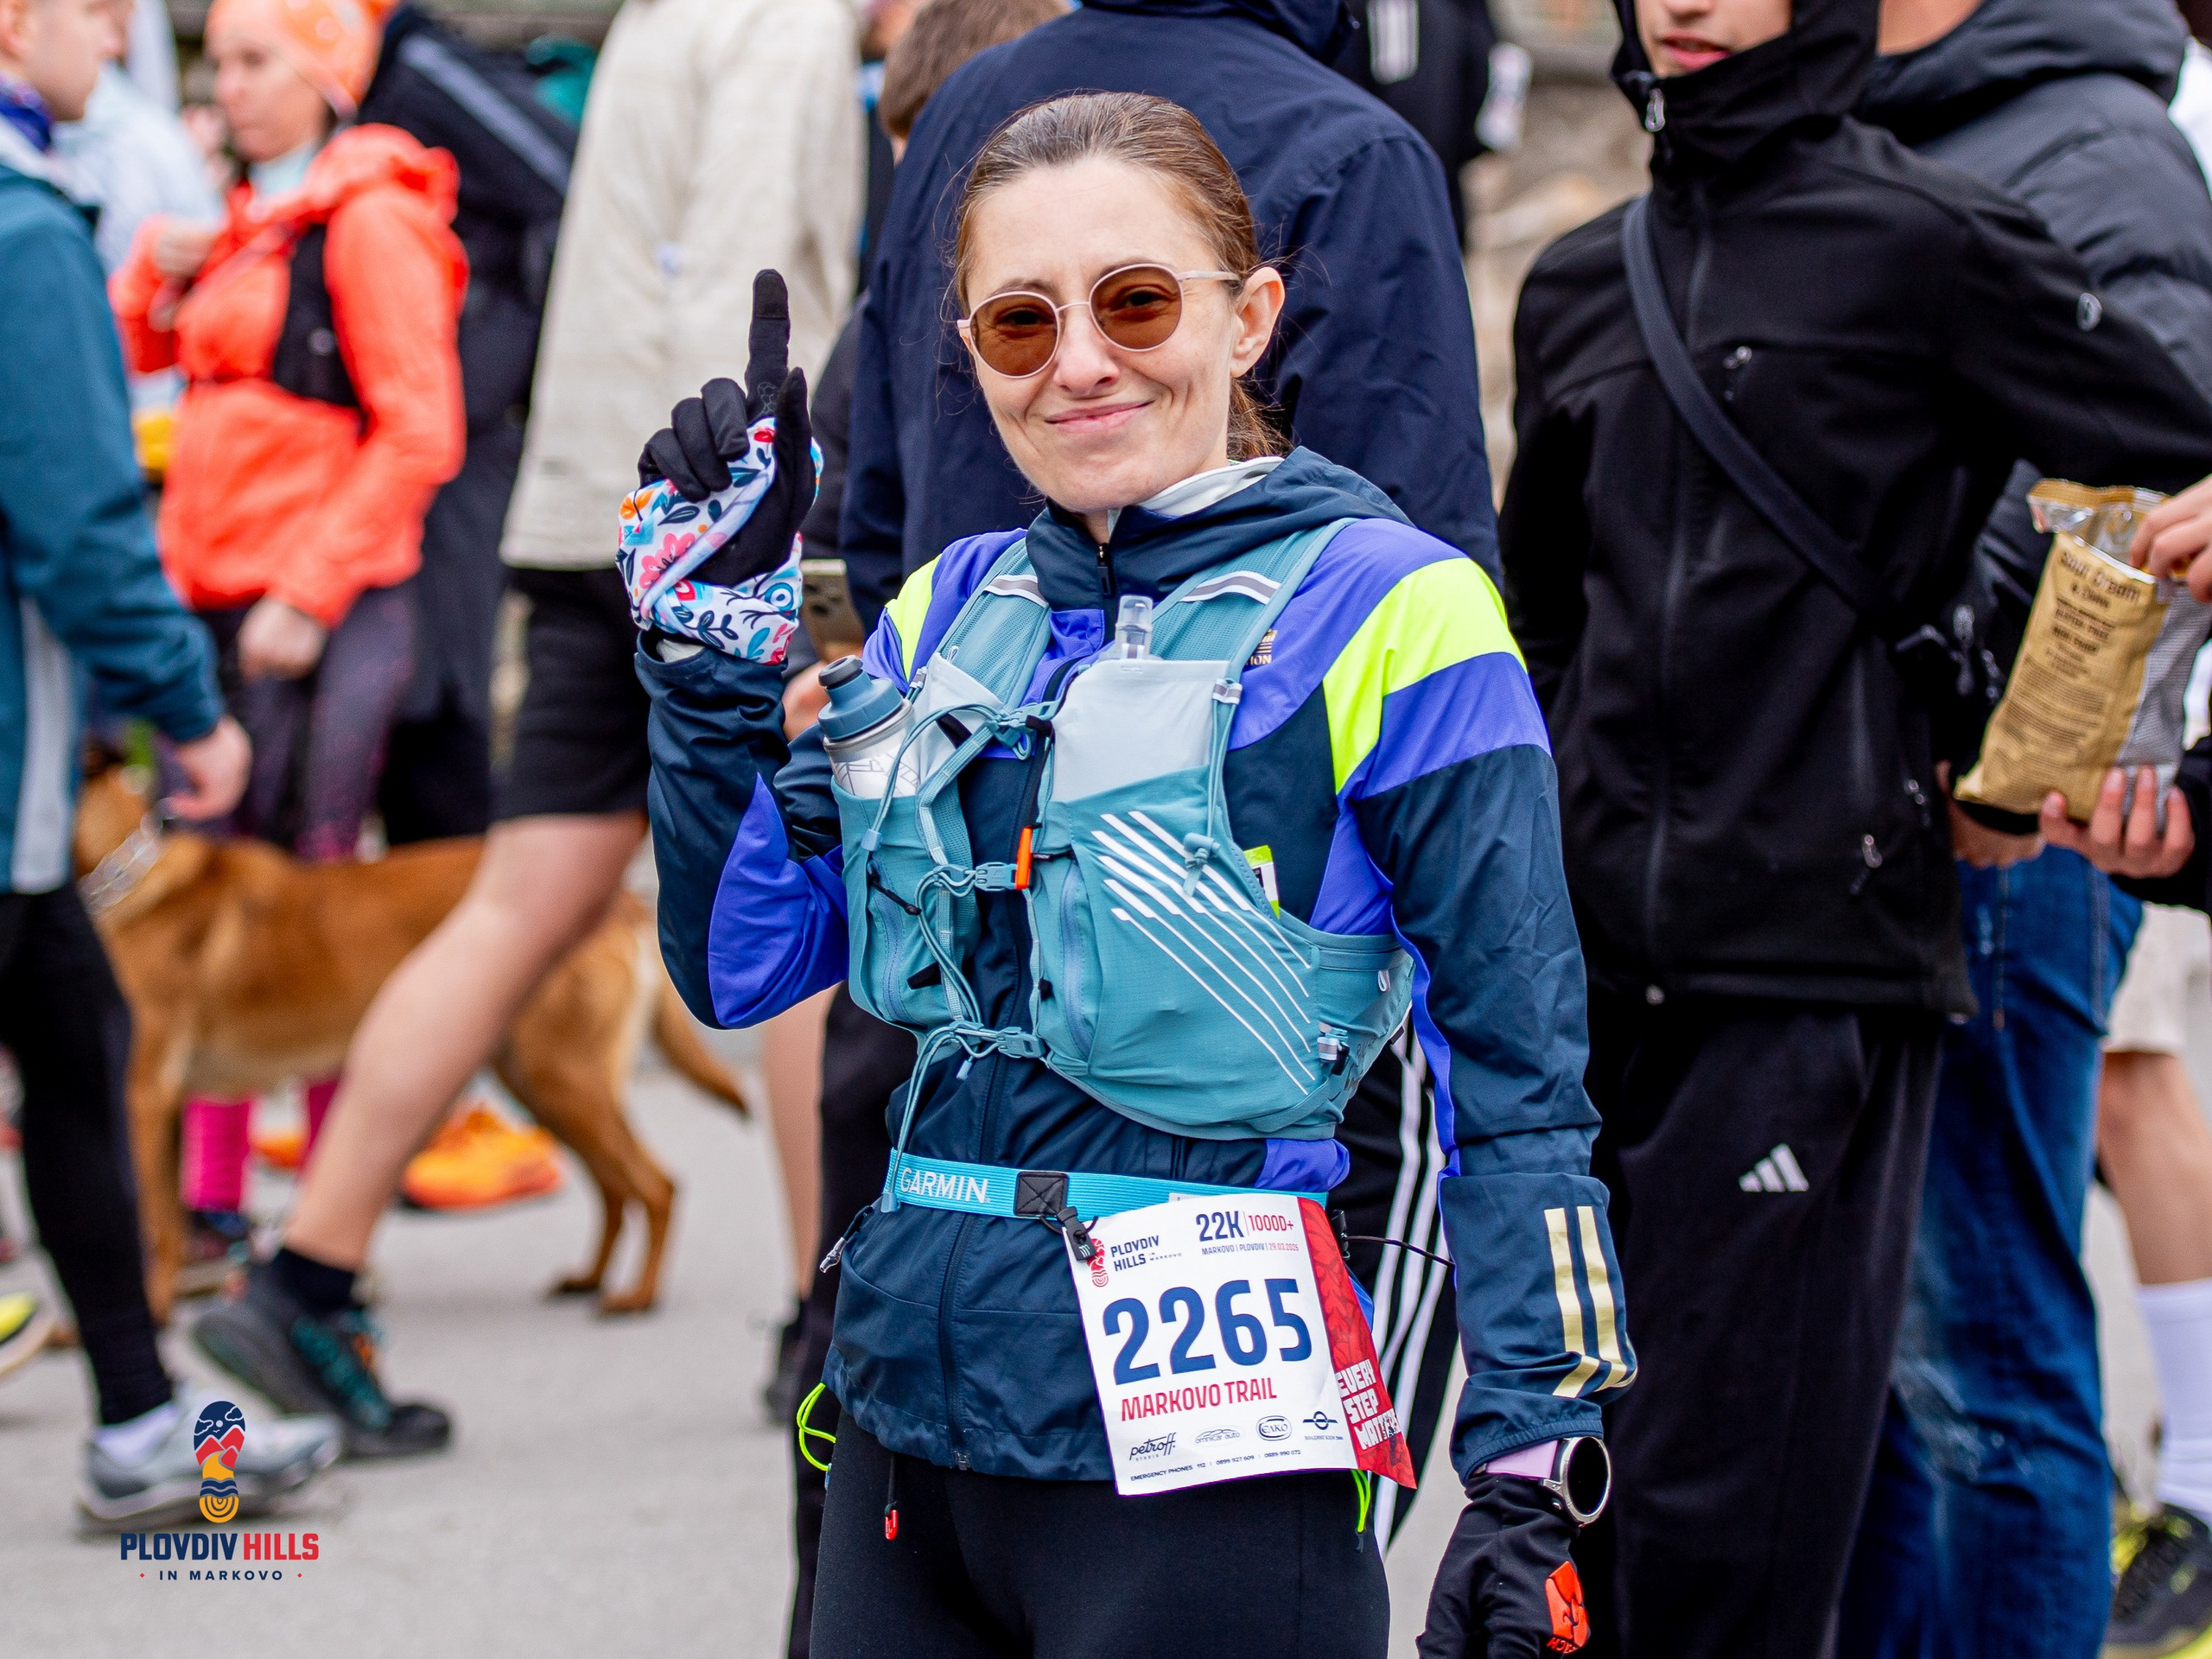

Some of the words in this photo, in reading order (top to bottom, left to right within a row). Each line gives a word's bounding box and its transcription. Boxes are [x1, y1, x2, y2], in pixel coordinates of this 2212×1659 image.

[900, 1166, 988, 1204] GARMIN
[1196, 1211, 1244, 1242] 22K
[1110, 1235, 1159, 1257] PLOVDIV
[1201, 1244, 1235, 1255] MARKOVO
[1239, 1243, 1265, 1252] PLOVDIV
[1114, 1253, 1147, 1272] HILLS
[1103, 1278, 1313, 1386] 2265
[1121, 1383, 1221, 1422] MARKOVO
[1224, 1377, 1277, 1404] TRAIL
[1343, 1388, 1379, 1424] STEP
[1130, 1470, 1166, 1482] EMERGENCY
[1168, 1465, 1193, 1474] PHONES
